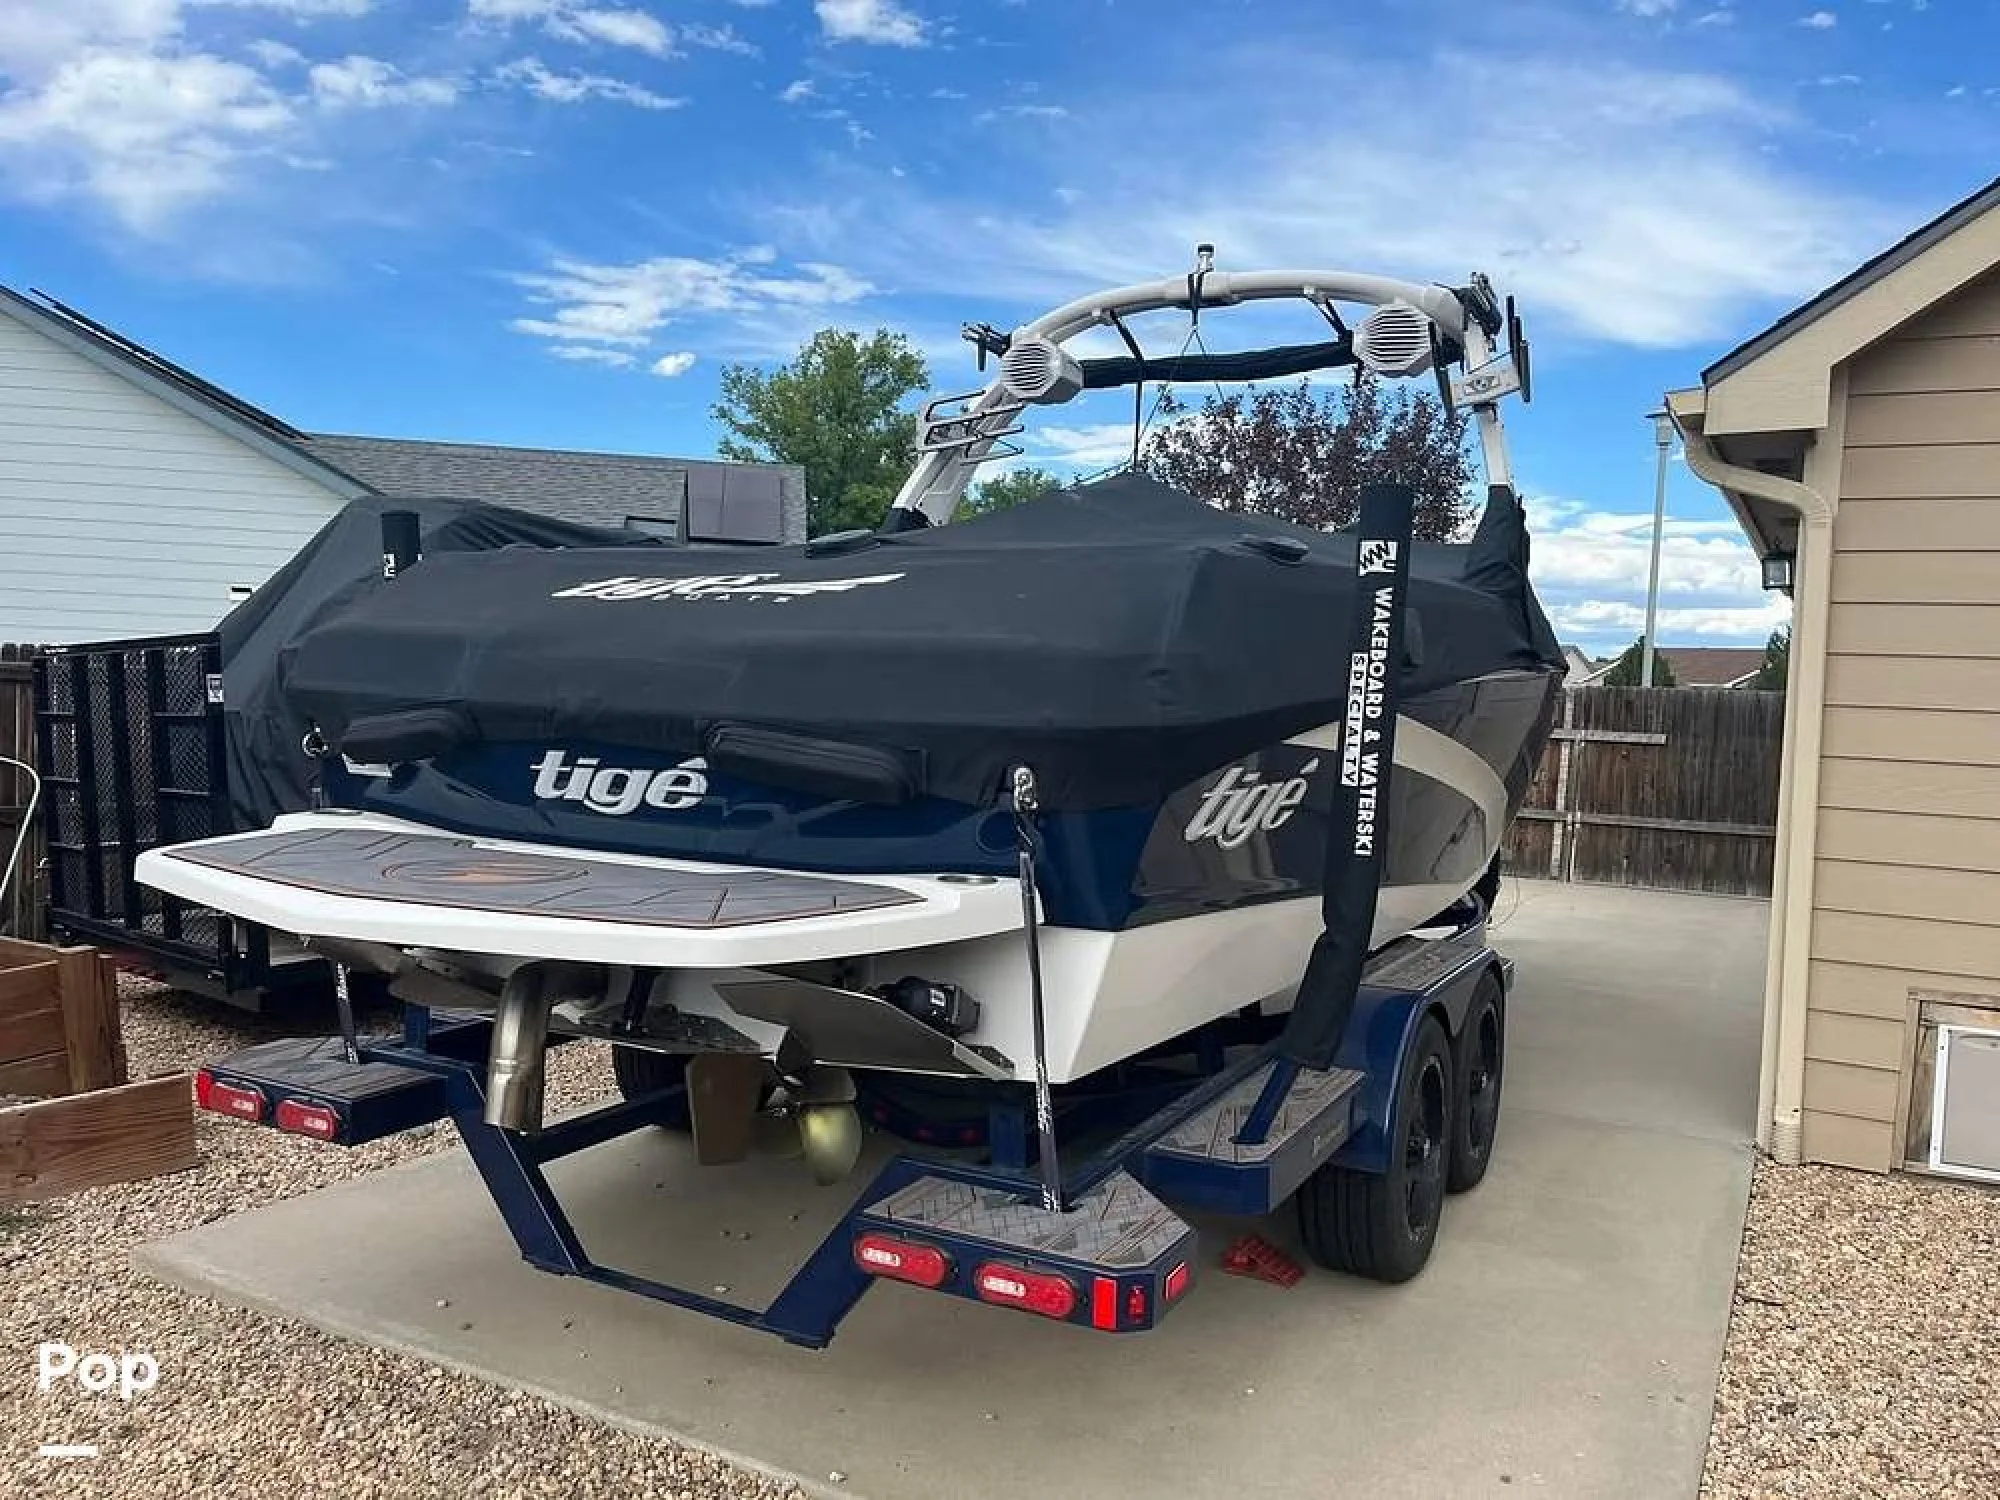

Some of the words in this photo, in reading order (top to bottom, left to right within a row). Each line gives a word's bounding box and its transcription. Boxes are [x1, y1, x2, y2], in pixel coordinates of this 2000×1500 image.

[1366, 587, 1393, 720] WAKEBOARD
[1343, 654, 1367, 784] SPECIALTY
[1363, 729, 1381, 743] &
[530, 750, 709, 815] tigé
[1184, 757, 1319, 850] tigé
[1354, 752, 1379, 857] WATERSKI
